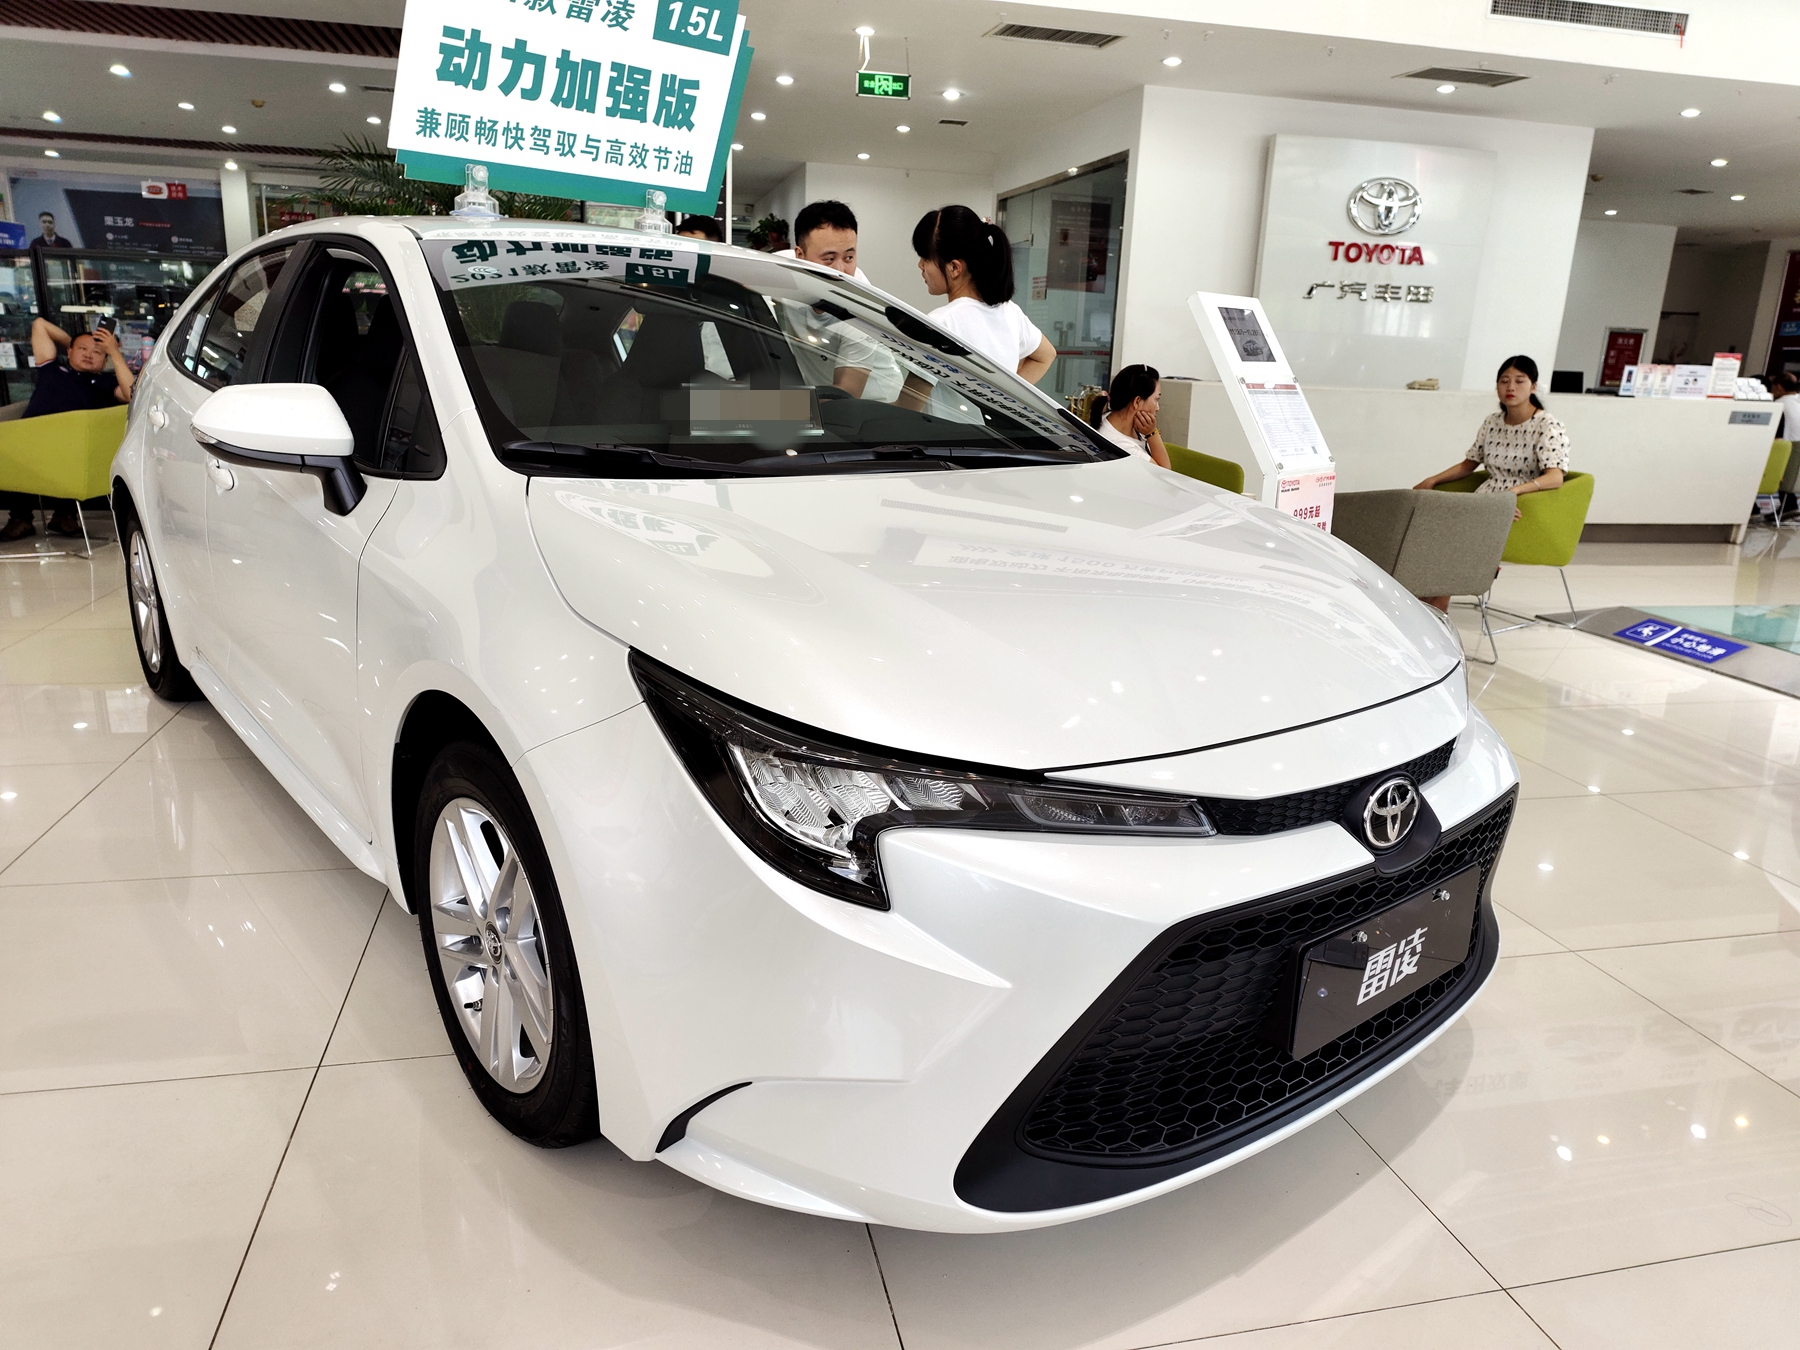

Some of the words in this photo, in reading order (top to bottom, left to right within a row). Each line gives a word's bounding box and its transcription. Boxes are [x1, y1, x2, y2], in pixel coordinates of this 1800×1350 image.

[668, 1, 724, 42] 1.5L
[436, 25, 700, 132] 动力加强版
[416, 106, 694, 177] 兼顾畅快驾驭与高效节油
[1328, 241, 1425, 265] TOYOTA
[1302, 280, 1435, 303] 广汽丰田
[1356, 926, 1429, 1006] 雷凌
